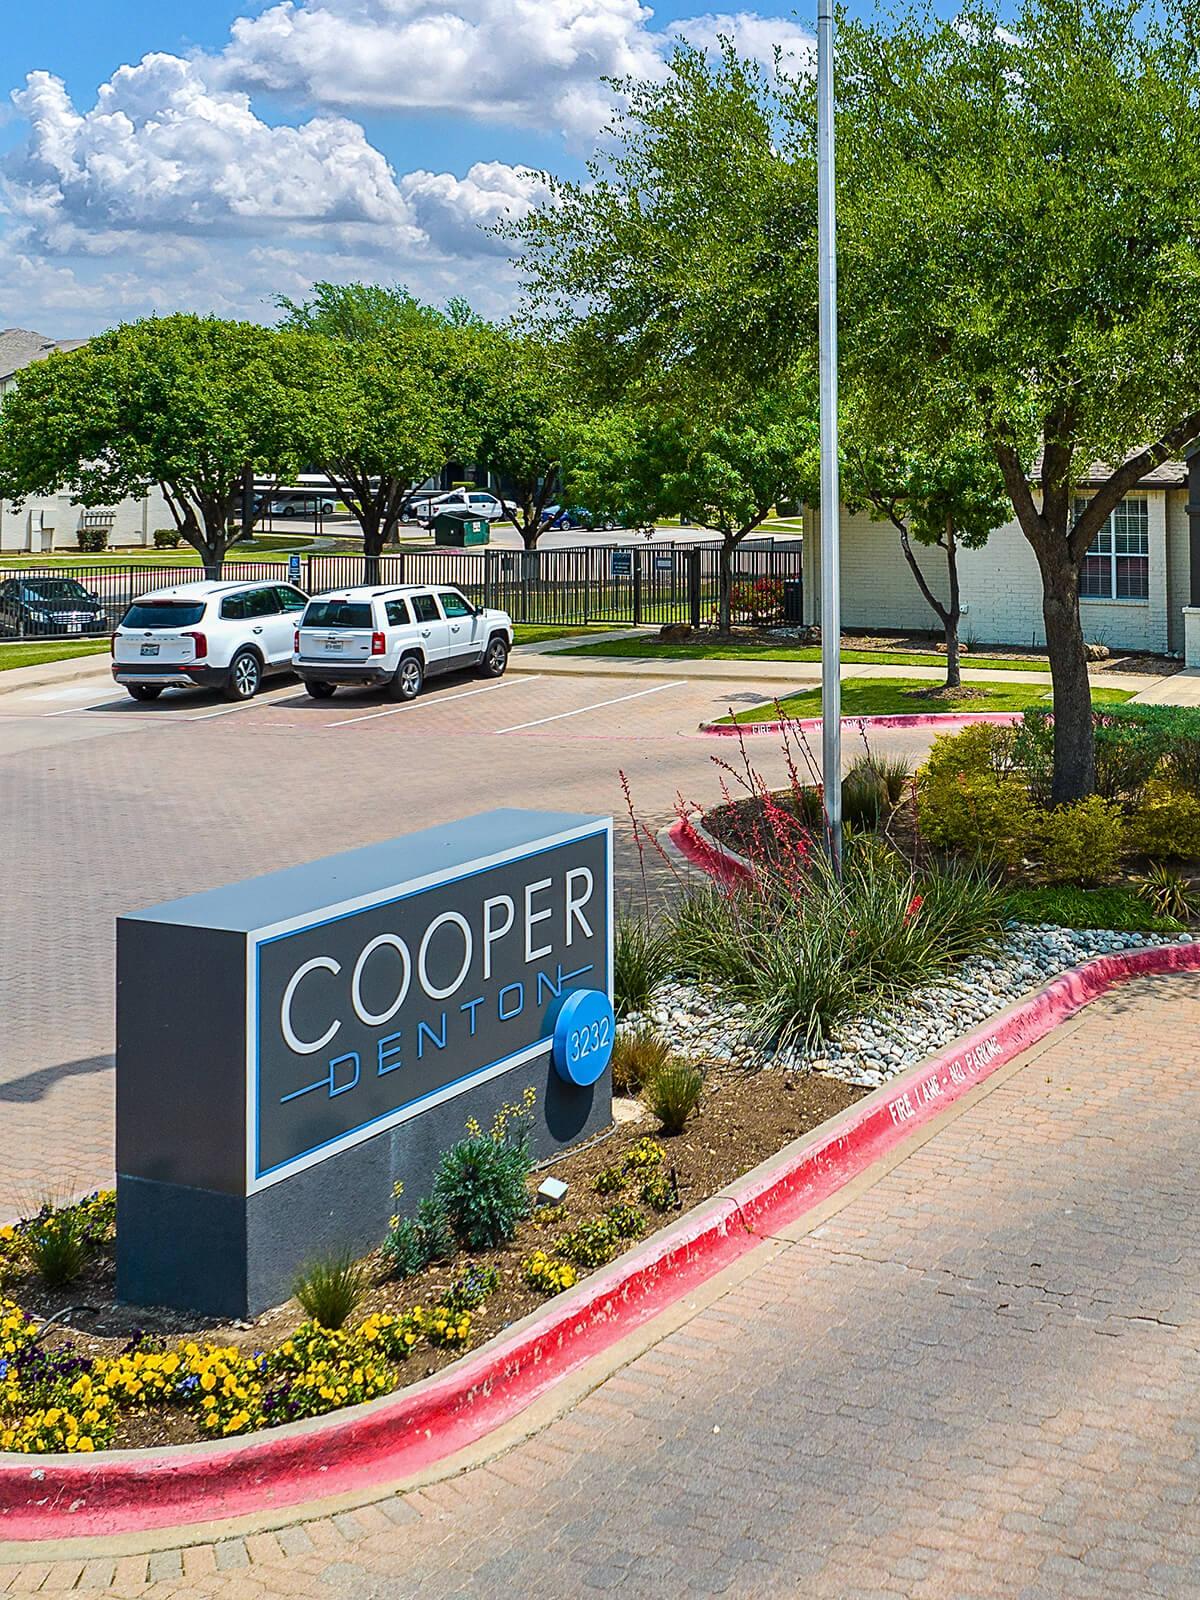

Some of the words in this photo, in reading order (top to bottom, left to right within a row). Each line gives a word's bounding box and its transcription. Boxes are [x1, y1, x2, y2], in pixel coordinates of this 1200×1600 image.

[281, 866, 594, 1055] COOPER
[328, 964, 562, 1098] DENTON
[571, 1016, 609, 1062] 3232
[888, 1092, 916, 1126] FIRE
[948, 1060, 967, 1085] NO
[964, 1036, 1004, 1074] PARKING
